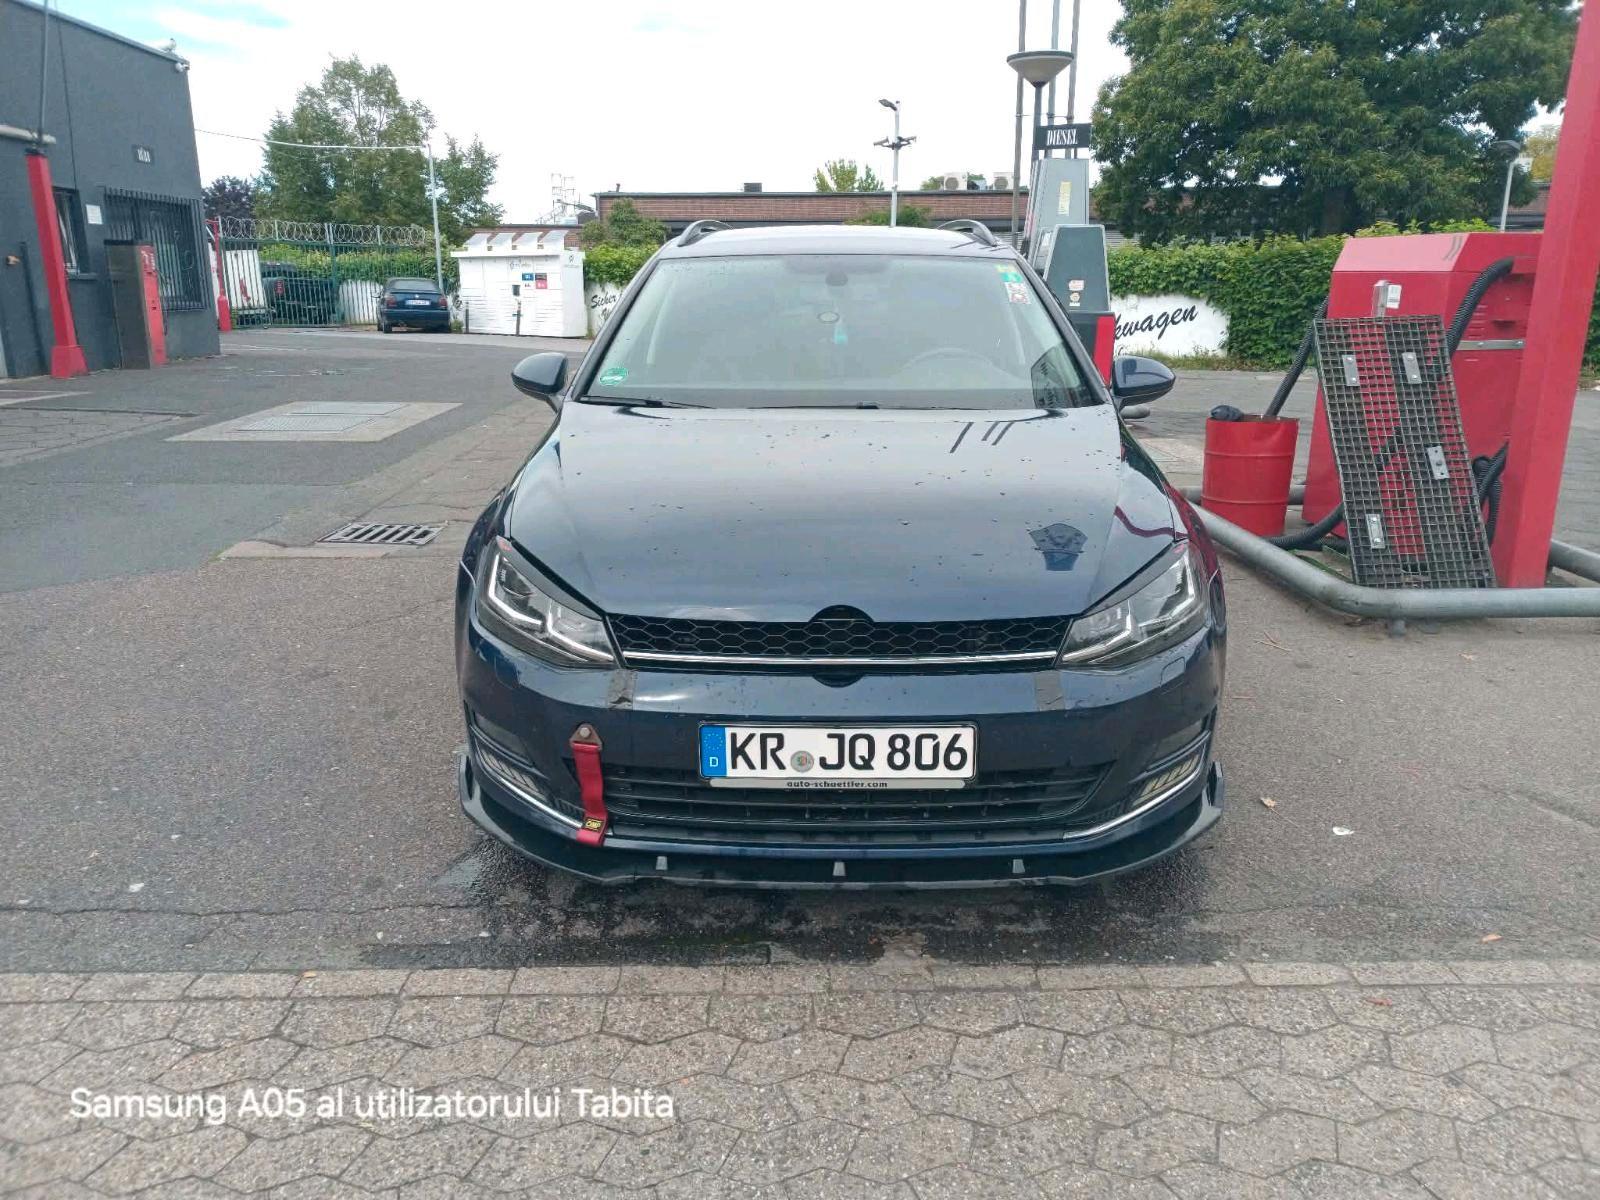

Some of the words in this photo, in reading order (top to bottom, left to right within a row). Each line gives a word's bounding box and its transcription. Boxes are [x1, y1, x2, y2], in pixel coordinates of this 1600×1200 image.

[1046, 128, 1078, 146] DIESEL
[709, 756, 719, 768] D
[730, 732, 787, 771] KR
[819, 732, 876, 771] JQ
[886, 732, 968, 772] 806
